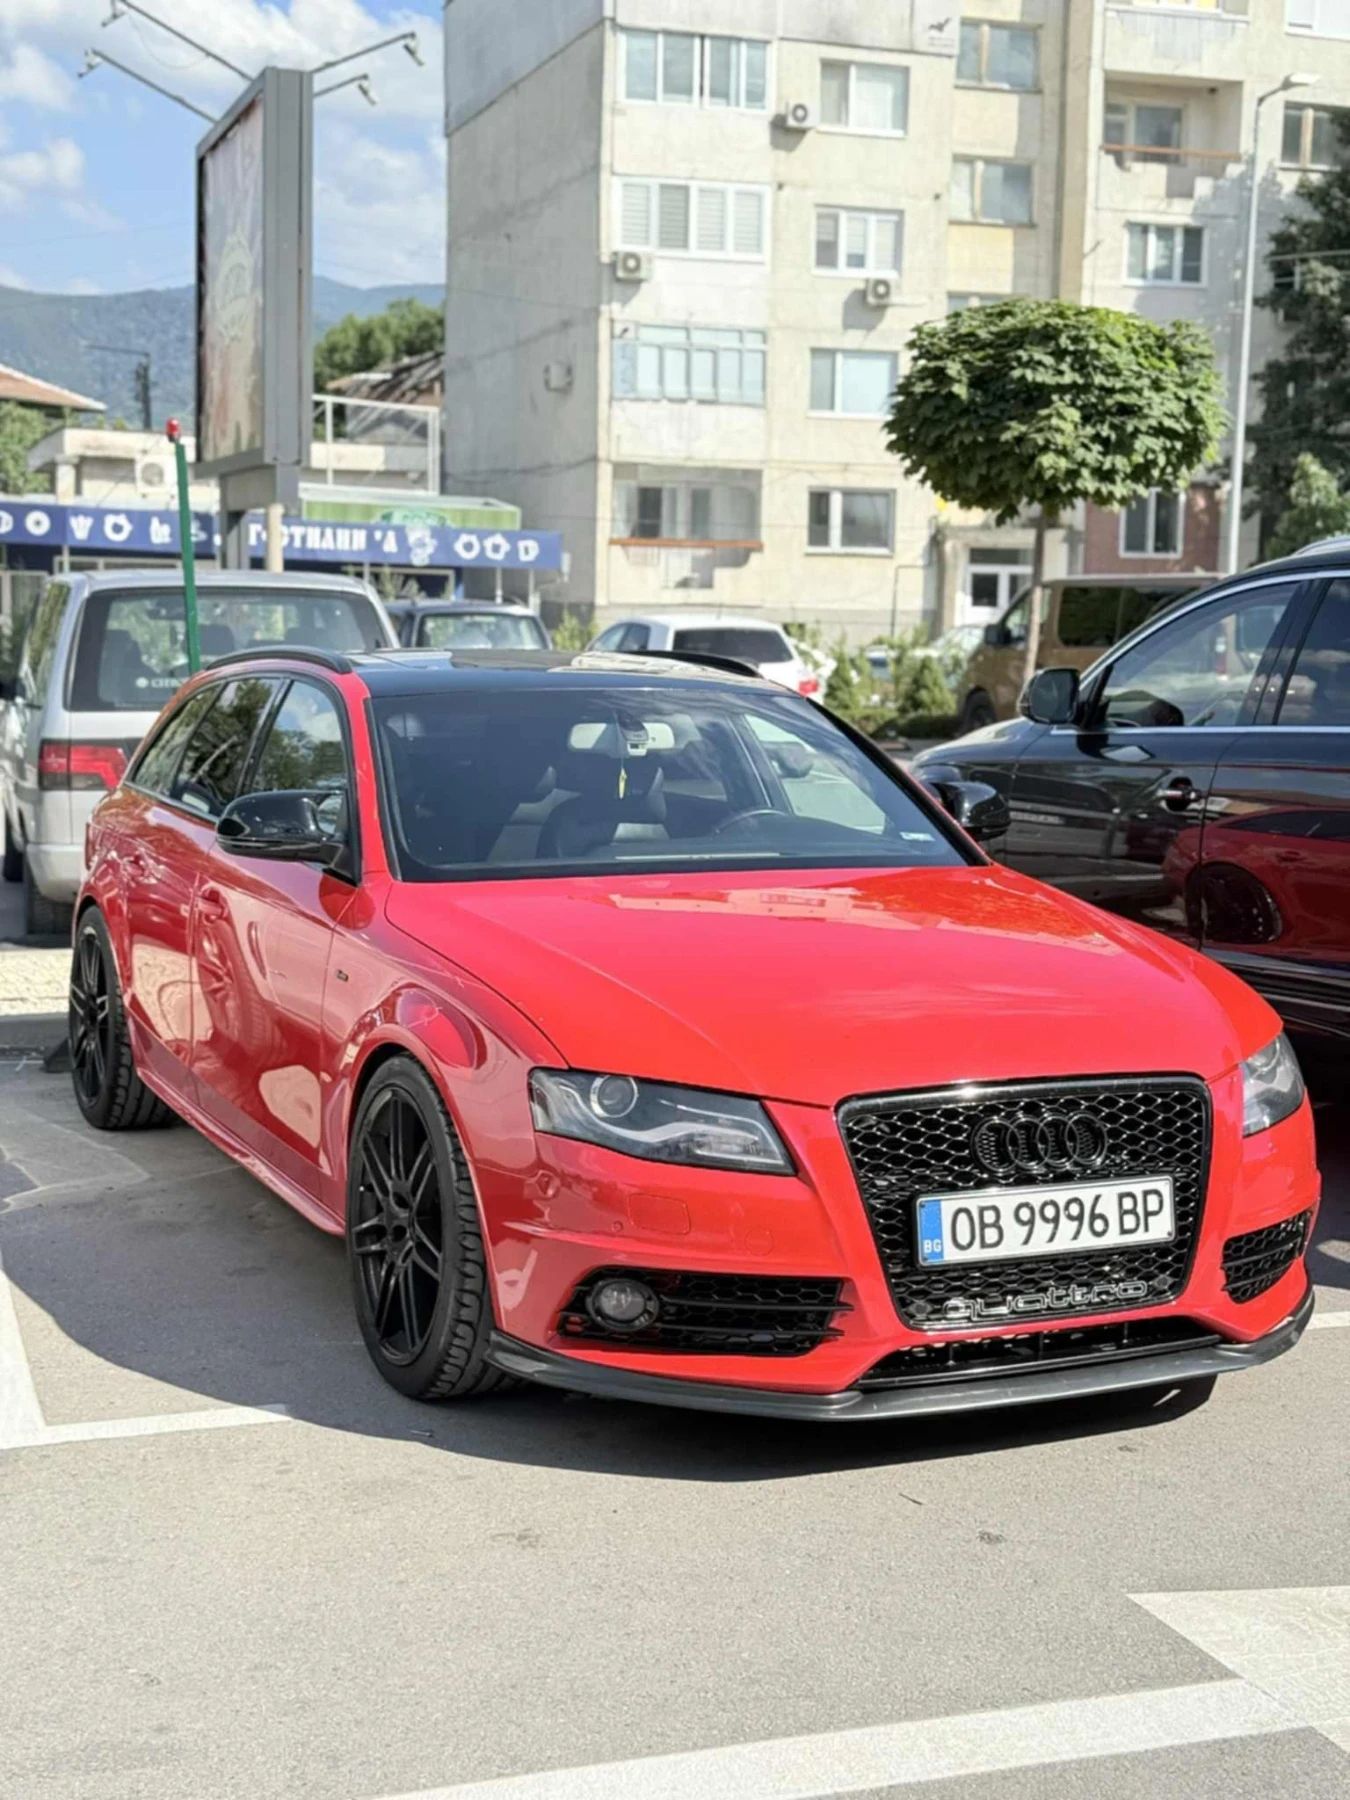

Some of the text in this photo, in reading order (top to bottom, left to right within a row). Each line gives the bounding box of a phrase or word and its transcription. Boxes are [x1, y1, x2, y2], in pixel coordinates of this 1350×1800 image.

[951, 1188, 1164, 1251] OB 9996 BP
[923, 1238, 942, 1254] BG
[942, 1280, 1148, 1322] quattro
